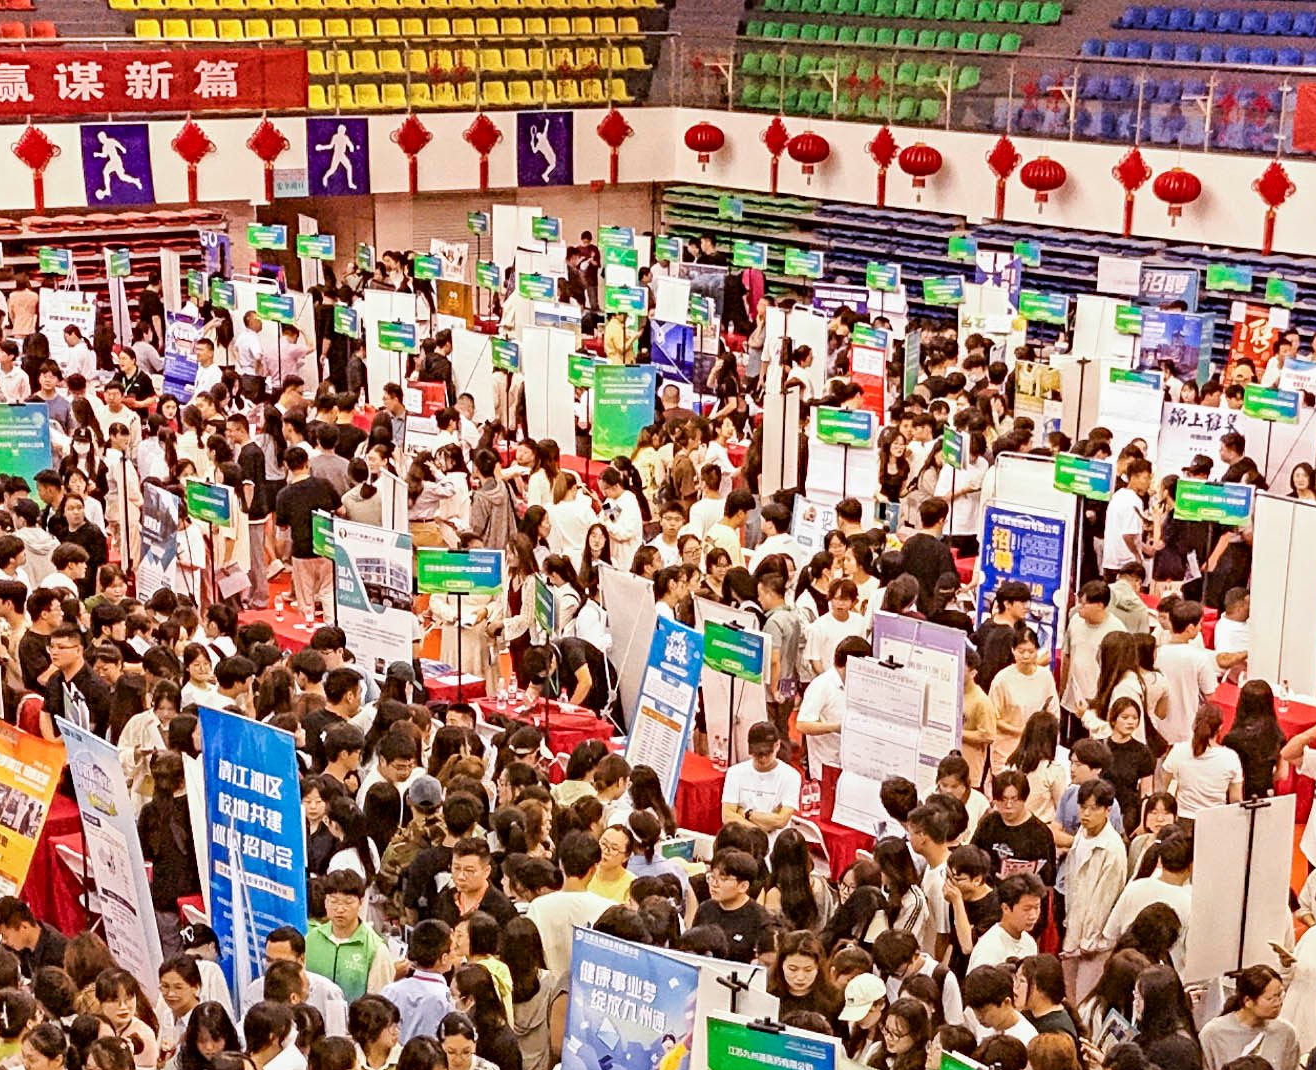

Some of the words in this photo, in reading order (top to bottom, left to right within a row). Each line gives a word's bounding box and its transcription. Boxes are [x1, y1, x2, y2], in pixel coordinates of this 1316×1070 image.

[218, 758, 283, 800] 清江浦区
[218, 792, 282, 834] 校地共建
[580, 960, 657, 1001] 健康事业梦
[590, 988, 667, 1034] 绽放九州通
